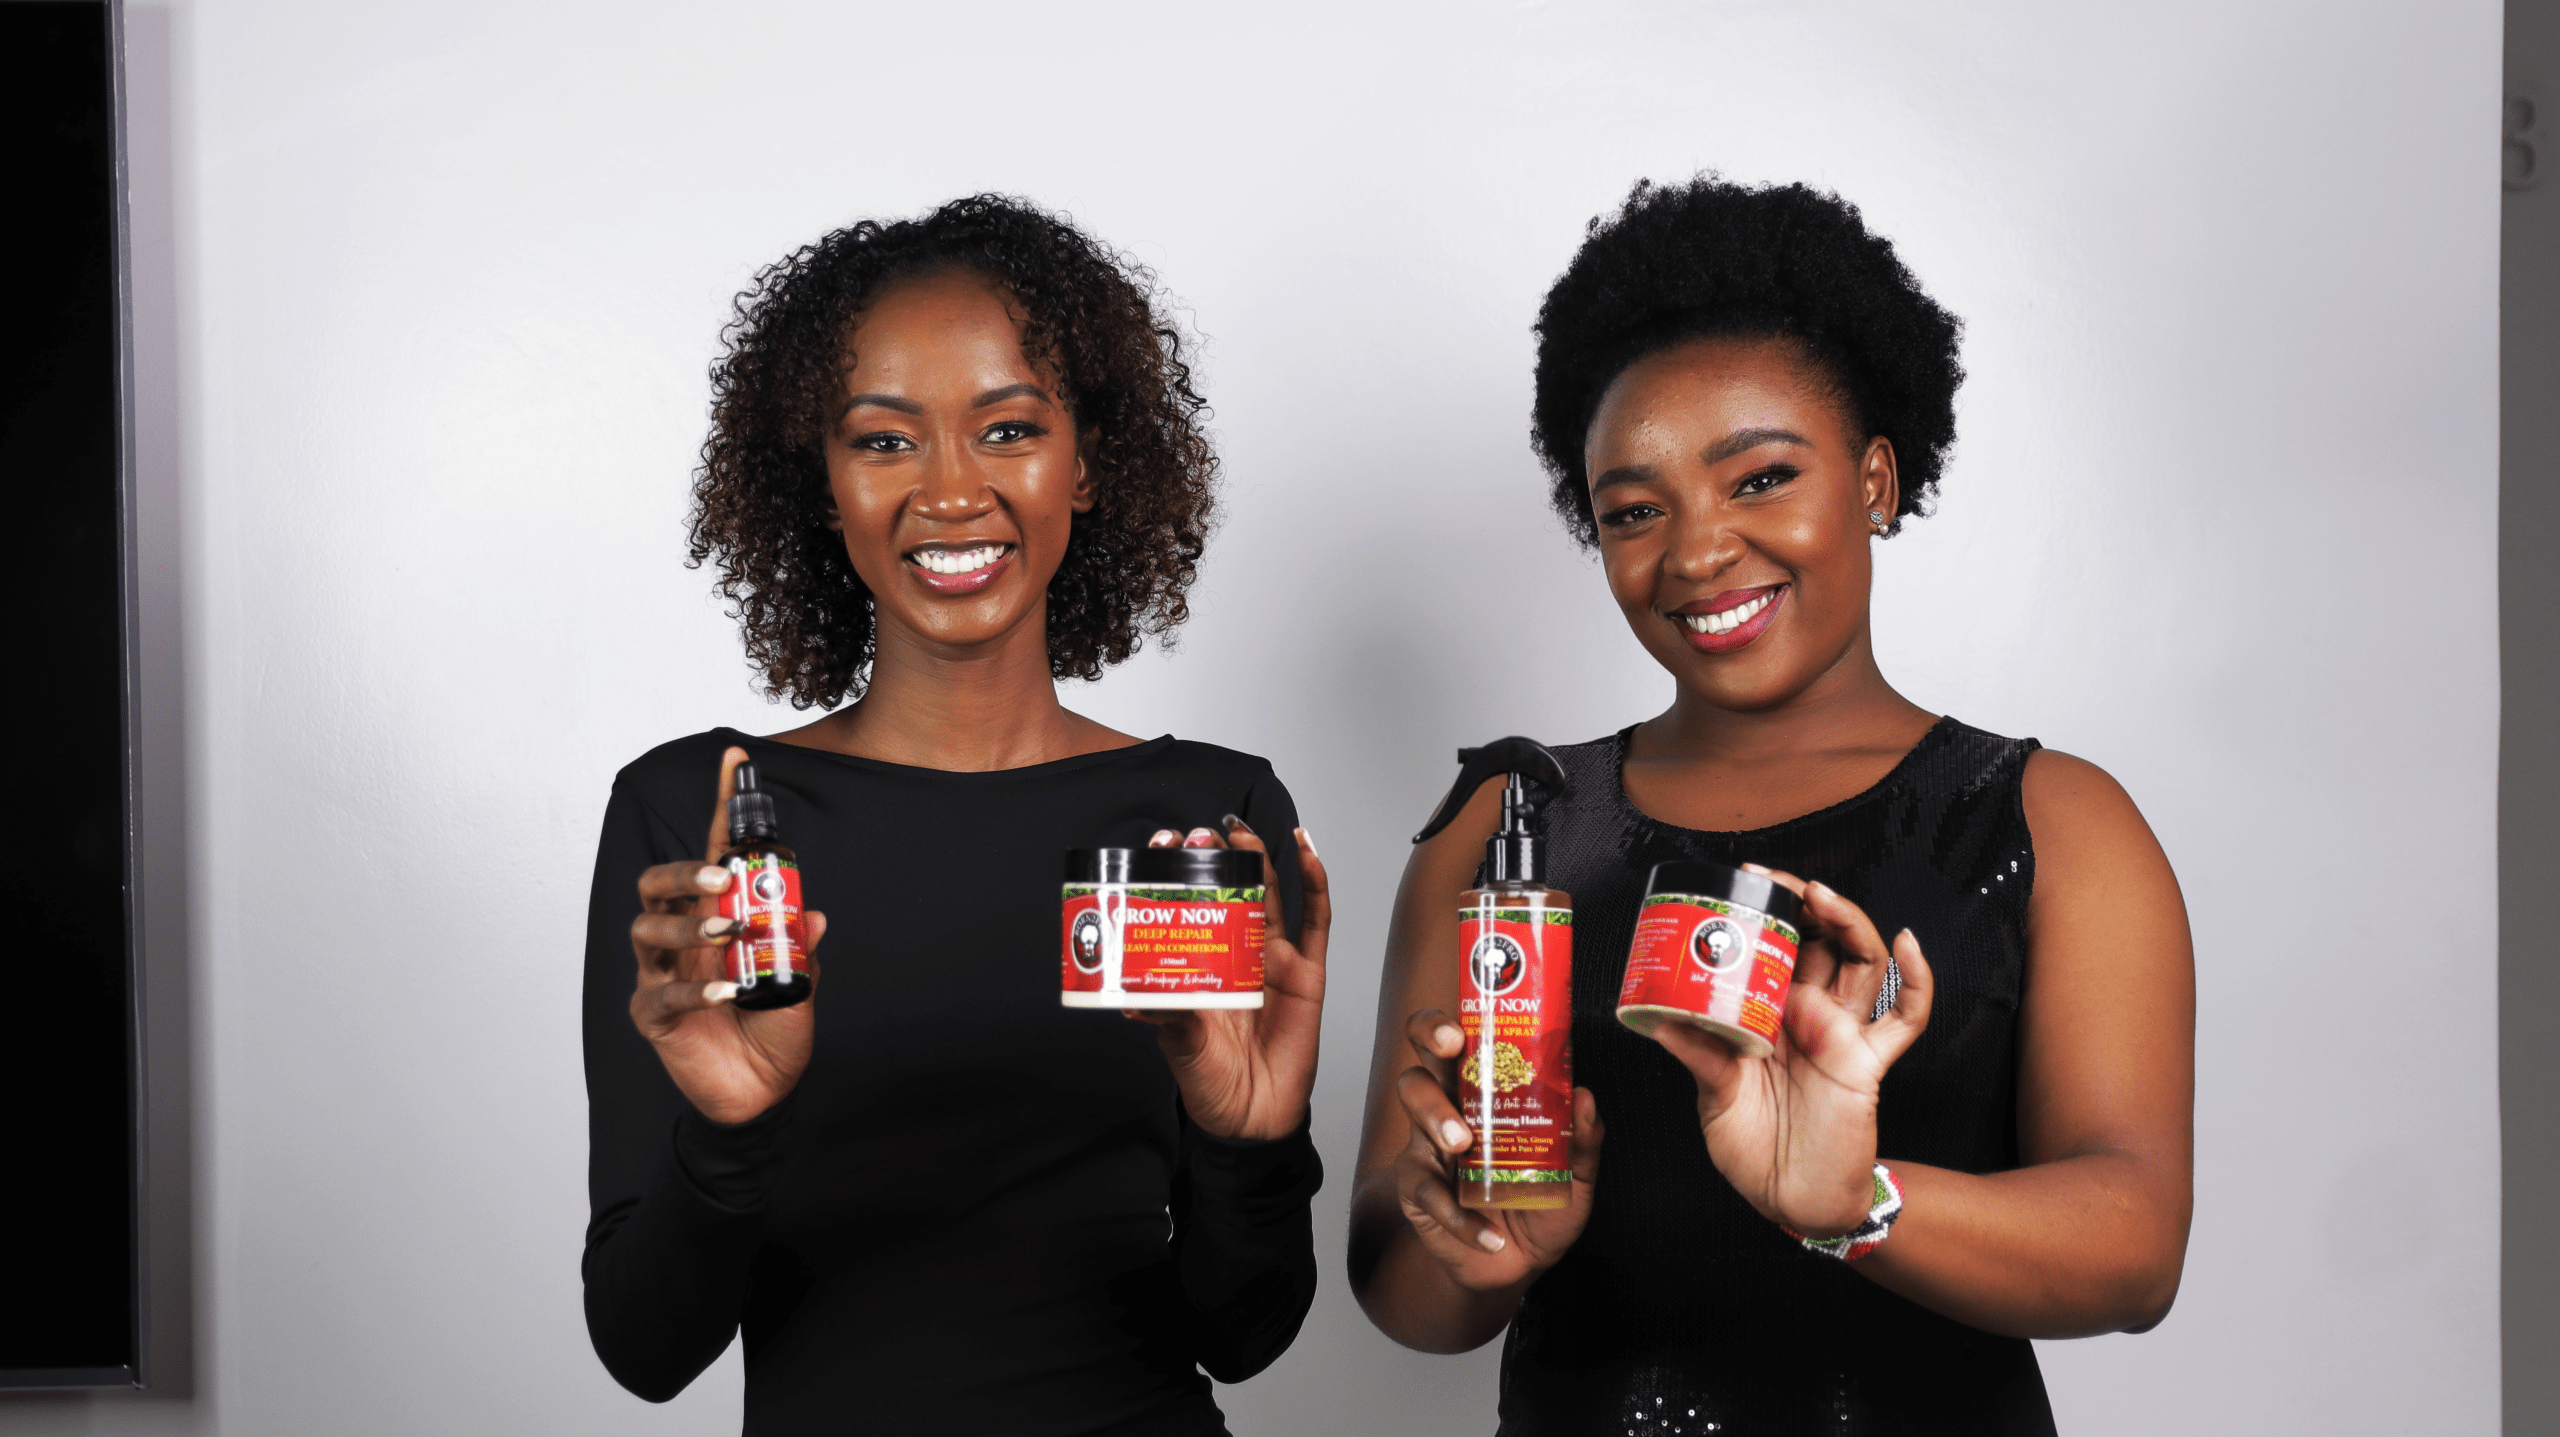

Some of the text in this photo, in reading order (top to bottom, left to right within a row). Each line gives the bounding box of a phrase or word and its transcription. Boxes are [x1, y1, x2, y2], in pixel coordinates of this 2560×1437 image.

[750, 904, 777, 915] ROW
[1181, 908, 1228, 924] NOW
[1133, 928, 1213, 939] DEEP REPAIR
[1167, 943, 1229, 953] CONDITIONER
[1500, 998, 1541, 1012] NOW
[1503, 1027, 1536, 1036] SPRAY
[1520, 1115, 1553, 1125] Hairline
